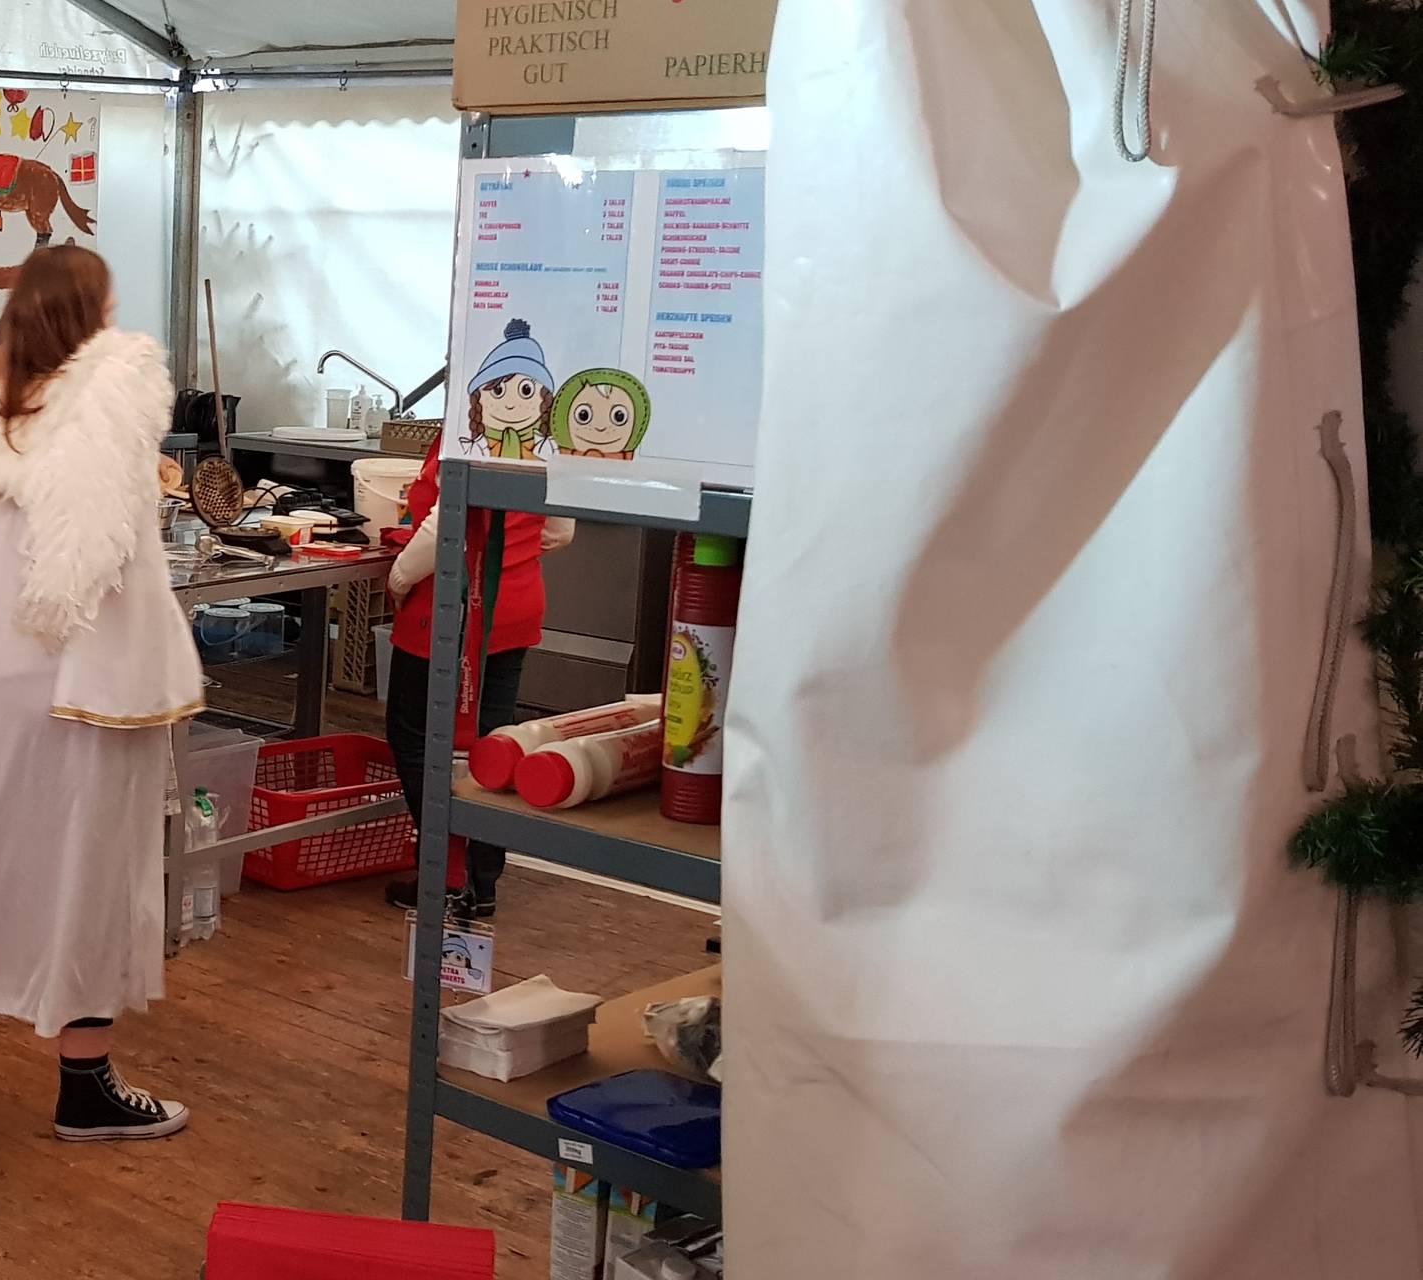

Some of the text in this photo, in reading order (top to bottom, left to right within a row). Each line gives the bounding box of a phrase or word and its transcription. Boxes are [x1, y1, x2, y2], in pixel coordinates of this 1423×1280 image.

[484, 0, 619, 28] HYGIENISCH
[488, 29, 610, 57] PRAKTISCH
[523, 62, 569, 85] GUT
